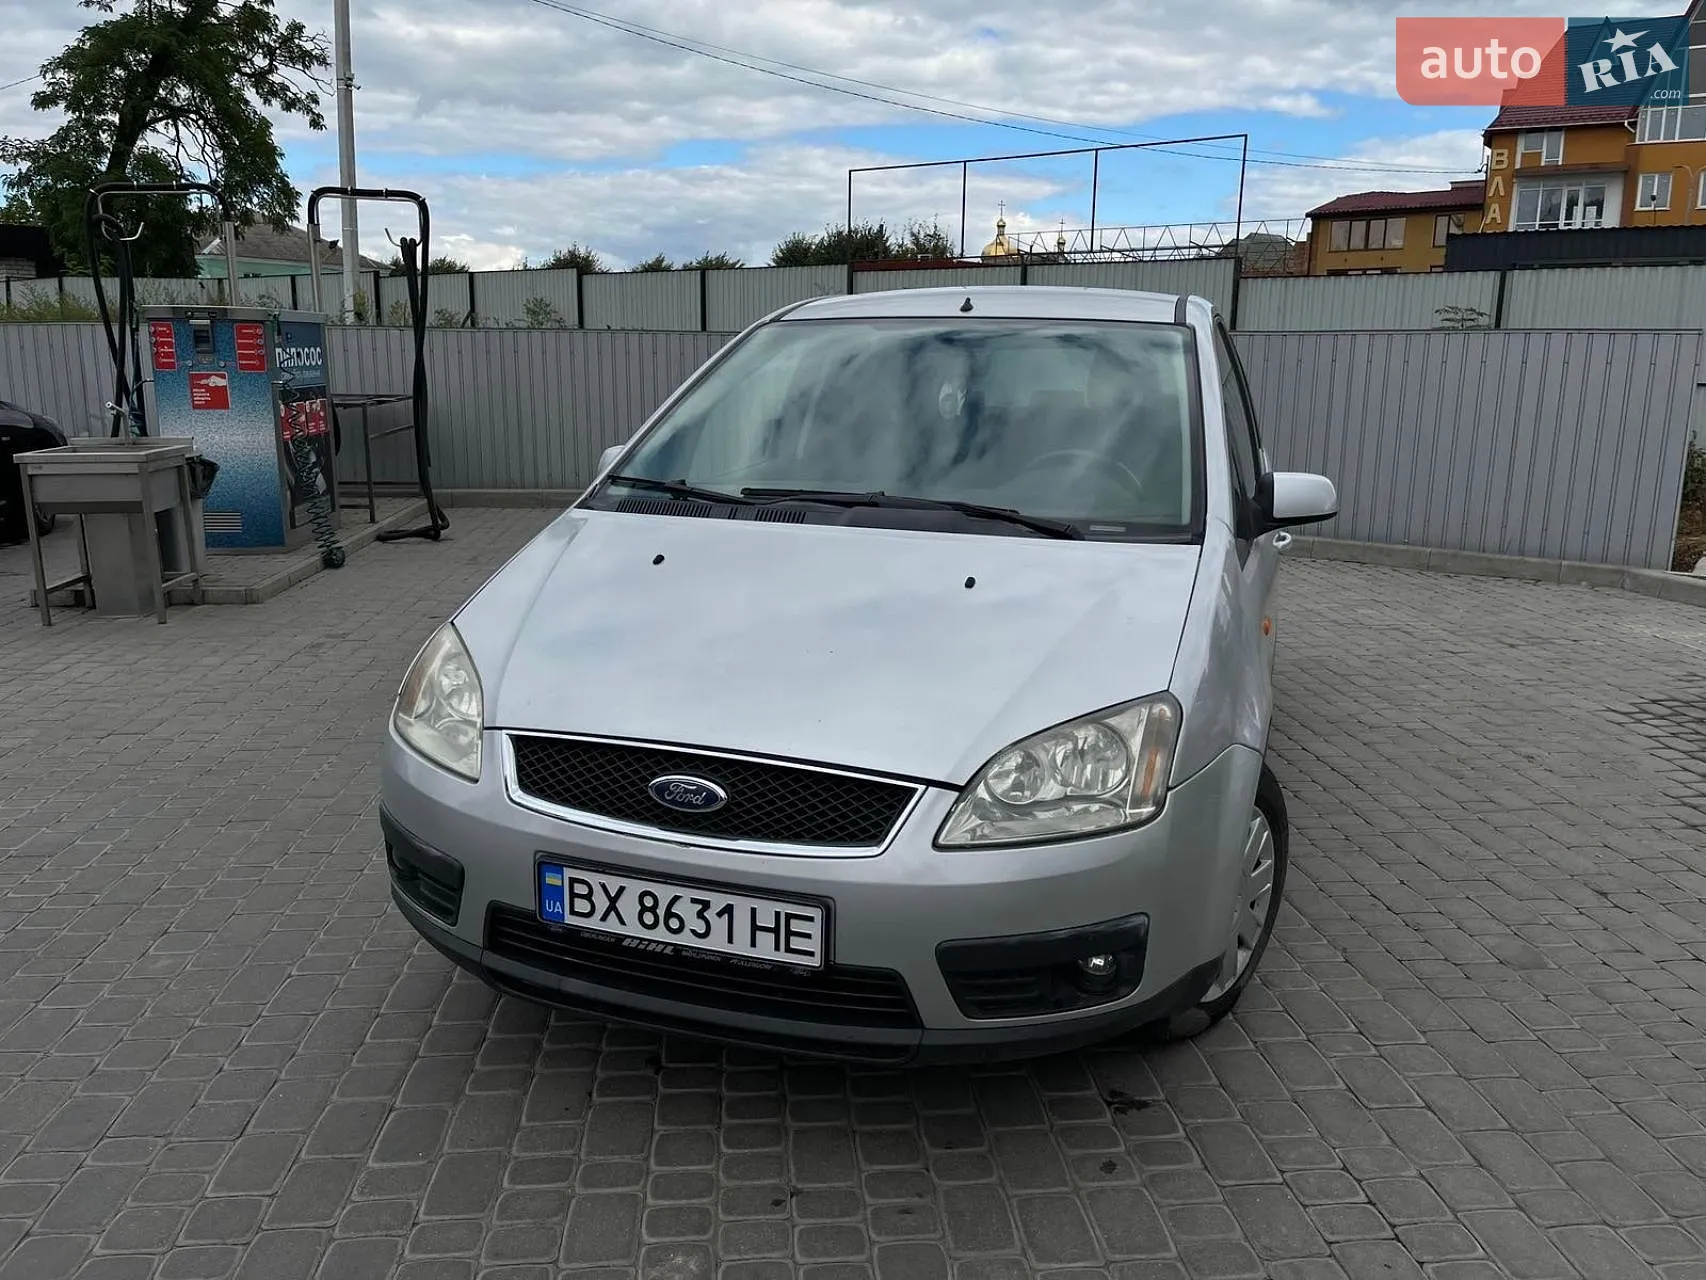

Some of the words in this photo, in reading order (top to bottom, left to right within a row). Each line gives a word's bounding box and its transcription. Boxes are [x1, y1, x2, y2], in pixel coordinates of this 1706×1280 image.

[1485, 148, 1509, 233] ВЛА
[664, 782, 707, 805] Ford
[545, 899, 563, 914] UA
[568, 876, 627, 927] BX
[638, 889, 735, 945] 8631
[750, 906, 816, 958] HE
